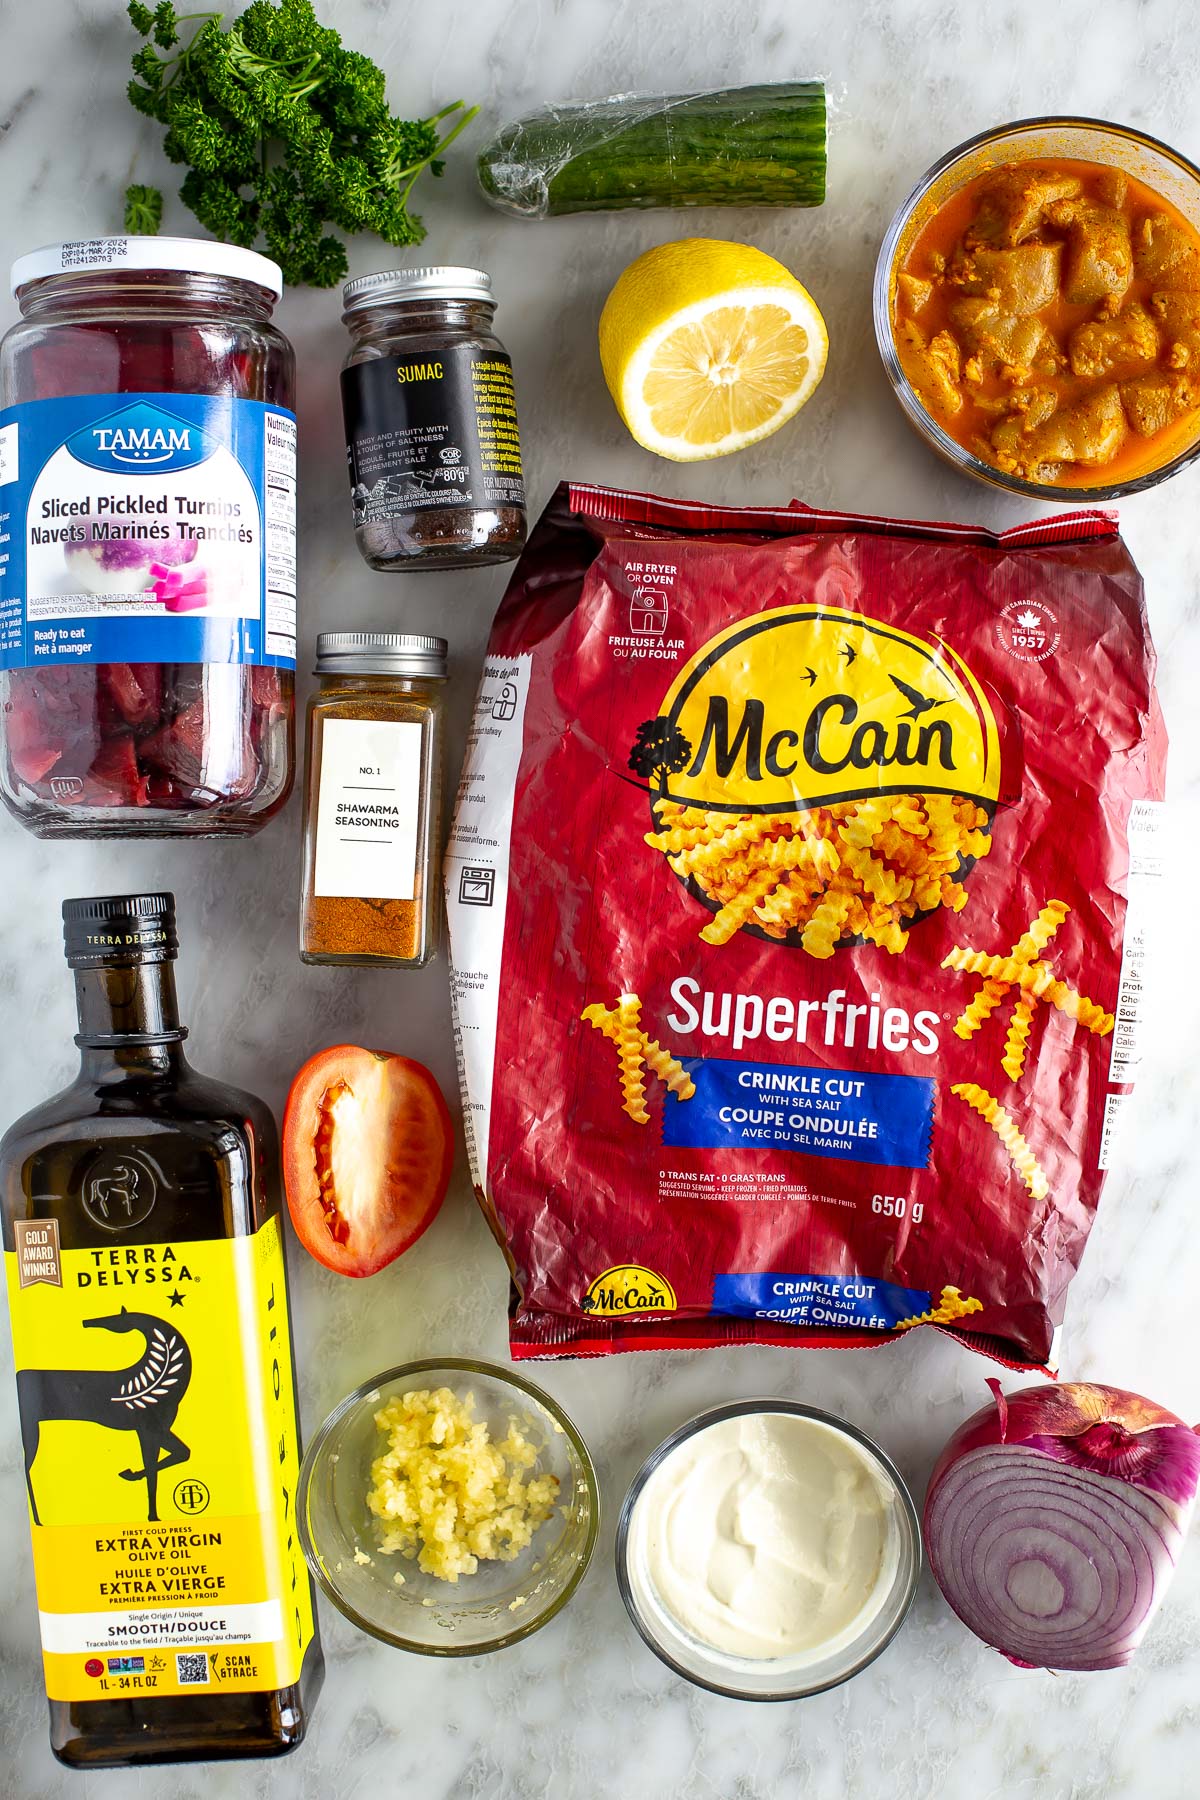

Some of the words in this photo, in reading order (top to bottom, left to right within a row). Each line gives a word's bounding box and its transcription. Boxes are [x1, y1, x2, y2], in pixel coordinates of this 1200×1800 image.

[397, 362, 443, 383] SUMAC
[93, 428, 191, 451] TAMAM
[377, 433, 393, 442] AND
[395, 428, 424, 437] FRUITY
[426, 425, 449, 434] WITH
[362, 442, 384, 453] TOUCH
[385, 440, 397, 448] OF
[398, 433, 444, 446] SALTINESS
[417, 446, 429, 454] ET
[404, 455, 427, 466] SALÉ
[443, 469, 457, 482] 80
[458, 471, 465, 483] g
[483, 476, 494, 488] FOR
[41, 496, 91, 519] Sliced
[97, 494, 168, 515] Pickled
[174, 496, 241, 523] Turnips
[31, 525, 85, 545] Navets
[92, 519, 170, 541] Marinés
[176, 521, 253, 544] Tranchés
[624, 562, 643, 572] AIR
[645, 563, 678, 575] FRYER
[627, 573, 641, 583] OR
[642, 574, 675, 585] OVEN
[29, 596, 60, 606] SUGGESTED
[127, 592, 156, 602] PICTURE
[1009, 599, 1042, 609] CANADIAN
[106, 603, 130, 611] PHOTO
[34, 628, 58, 642] Ready
[59, 628, 69, 639] to
[70, 628, 86, 639] eat
[1011, 627, 1026, 635] SINCE
[34, 644, 50, 655] Prêt
[51, 643, 57, 654] à
[58, 643, 93, 655] manger
[608, 635, 655, 648] FRITEUSE
[656, 637, 666, 648] À
[667, 639, 685, 650] AIR
[1011, 635, 1046, 649] 1957
[613, 649, 629, 658] OU
[630, 649, 647, 659] AU
[648, 649, 678, 660] FOUR
[686, 693, 958, 782] McCain
[359, 767, 375, 775] NO.
[376, 767, 381, 776] 1
[468, 794, 486, 804] produit
[336, 803, 400, 815] SHAWARMA
[335, 816, 400, 829] SEASONING
[86, 935, 122, 945] TERRA
[125, 931, 167, 945] DELYSSA
[460, 971, 489, 981] couche
[666, 976, 941, 1055] Superfries
[737, 1071, 821, 1095] CRINKLE
[825, 1079, 865, 1098] CUT
[759, 1094, 790, 1107] WITH
[791, 1098, 813, 1110] SEA
[815, 1099, 842, 1112] SALT
[718, 1106, 785, 1127] COUPE
[788, 1114, 878, 1139] ONDULÉE
[741, 1127, 772, 1140] AVEC
[774, 1130, 791, 1142] DU
[792, 1133, 811, 1146] SEL
[813, 1136, 853, 1150] MARIN
[659, 1170, 665, 1179] 0
[667, 1171, 698, 1181] TRANS
[699, 1173, 715, 1182] FAT
[721, 1174, 728, 1183] 0
[729, 1174, 755, 1183] GRAS
[755, 1173, 786, 1183] TRANS
[659, 1180, 691, 1191] SUGGESTED
[691, 1183, 716, 1193] SERVING
[721, 1185, 736, 1193] KEEP
[736, 1185, 758, 1193] FROZEN
[763, 1185, 779, 1193] FRIED
[779, 1185, 808, 1193] POTATOES
[734, 1193, 757, 1201] GARDER
[786, 1193, 811, 1202] POMMES
[811, 1194, 820, 1202] DE
[820, 1195, 837, 1205] TERRE
[838, 1199, 857, 1209] FRITES
[871, 1194, 906, 1218] 650
[911, 1201, 924, 1224] g
[25, 1230, 48, 1245] GOLD
[23, 1246, 54, 1261] AWARD
[91, 1246, 177, 1267] TERRA
[22, 1262, 57, 1277] WINNER
[77, 1265, 193, 1288] DELYSSA
[772, 1281, 840, 1298] CRINKLE
[843, 1284, 876, 1299] CUT
[593, 1288, 666, 1311] McCain
[789, 1295, 814, 1305] WITH
[815, 1295, 833, 1306] SEA
[834, 1300, 857, 1310] SALT
[755, 1306, 809, 1319] COUPE
[811, 1307, 887, 1330] ONDULÉE
[122, 1529, 143, 1537] FIRST
[95, 1537, 152, 1552] EXTRA
[158, 1533, 222, 1549] VIRGIN
[128, 1551, 166, 1562] OLIVE
[170, 1549, 192, 1560] OIL
[115, 1568, 152, 1579] HUILE
[156, 1565, 208, 1577] D'OLIVE
[100, 1580, 157, 1595] EXTRA
[162, 1576, 226, 1592] VIERGE
[109, 1595, 146, 1604] PREMIÈRE
[147, 1593, 185, 1602] PRESSION
[187, 1592, 193, 1600] À
[195, 1591, 219, 1599] FROID
[128, 1613, 150, 1622] Single
[150, 1612, 173, 1622] Origin
[178, 1611, 204, 1620] Unique
[107, 1619, 228, 1637] SMOOTH/DOUCE
[85, 1638, 119, 1648] Traceable
[120, 1639, 129, 1647] to
[129, 1637, 141, 1646] the
[142, 1636, 158, 1645] field
[164, 1634, 194, 1645] Traçable
[194, 1633, 224, 1643] jusqu'au
[225, 1632, 252, 1642] champs
[225, 1655, 251, 1667] SCAN
[220, 1666, 258, 1678] &TRACE
[99, 1678, 110, 1690] 1L
[119, 1677, 130, 1689] 34
[132, 1676, 144, 1688] FL
[145, 1675, 158, 1687] OZ
